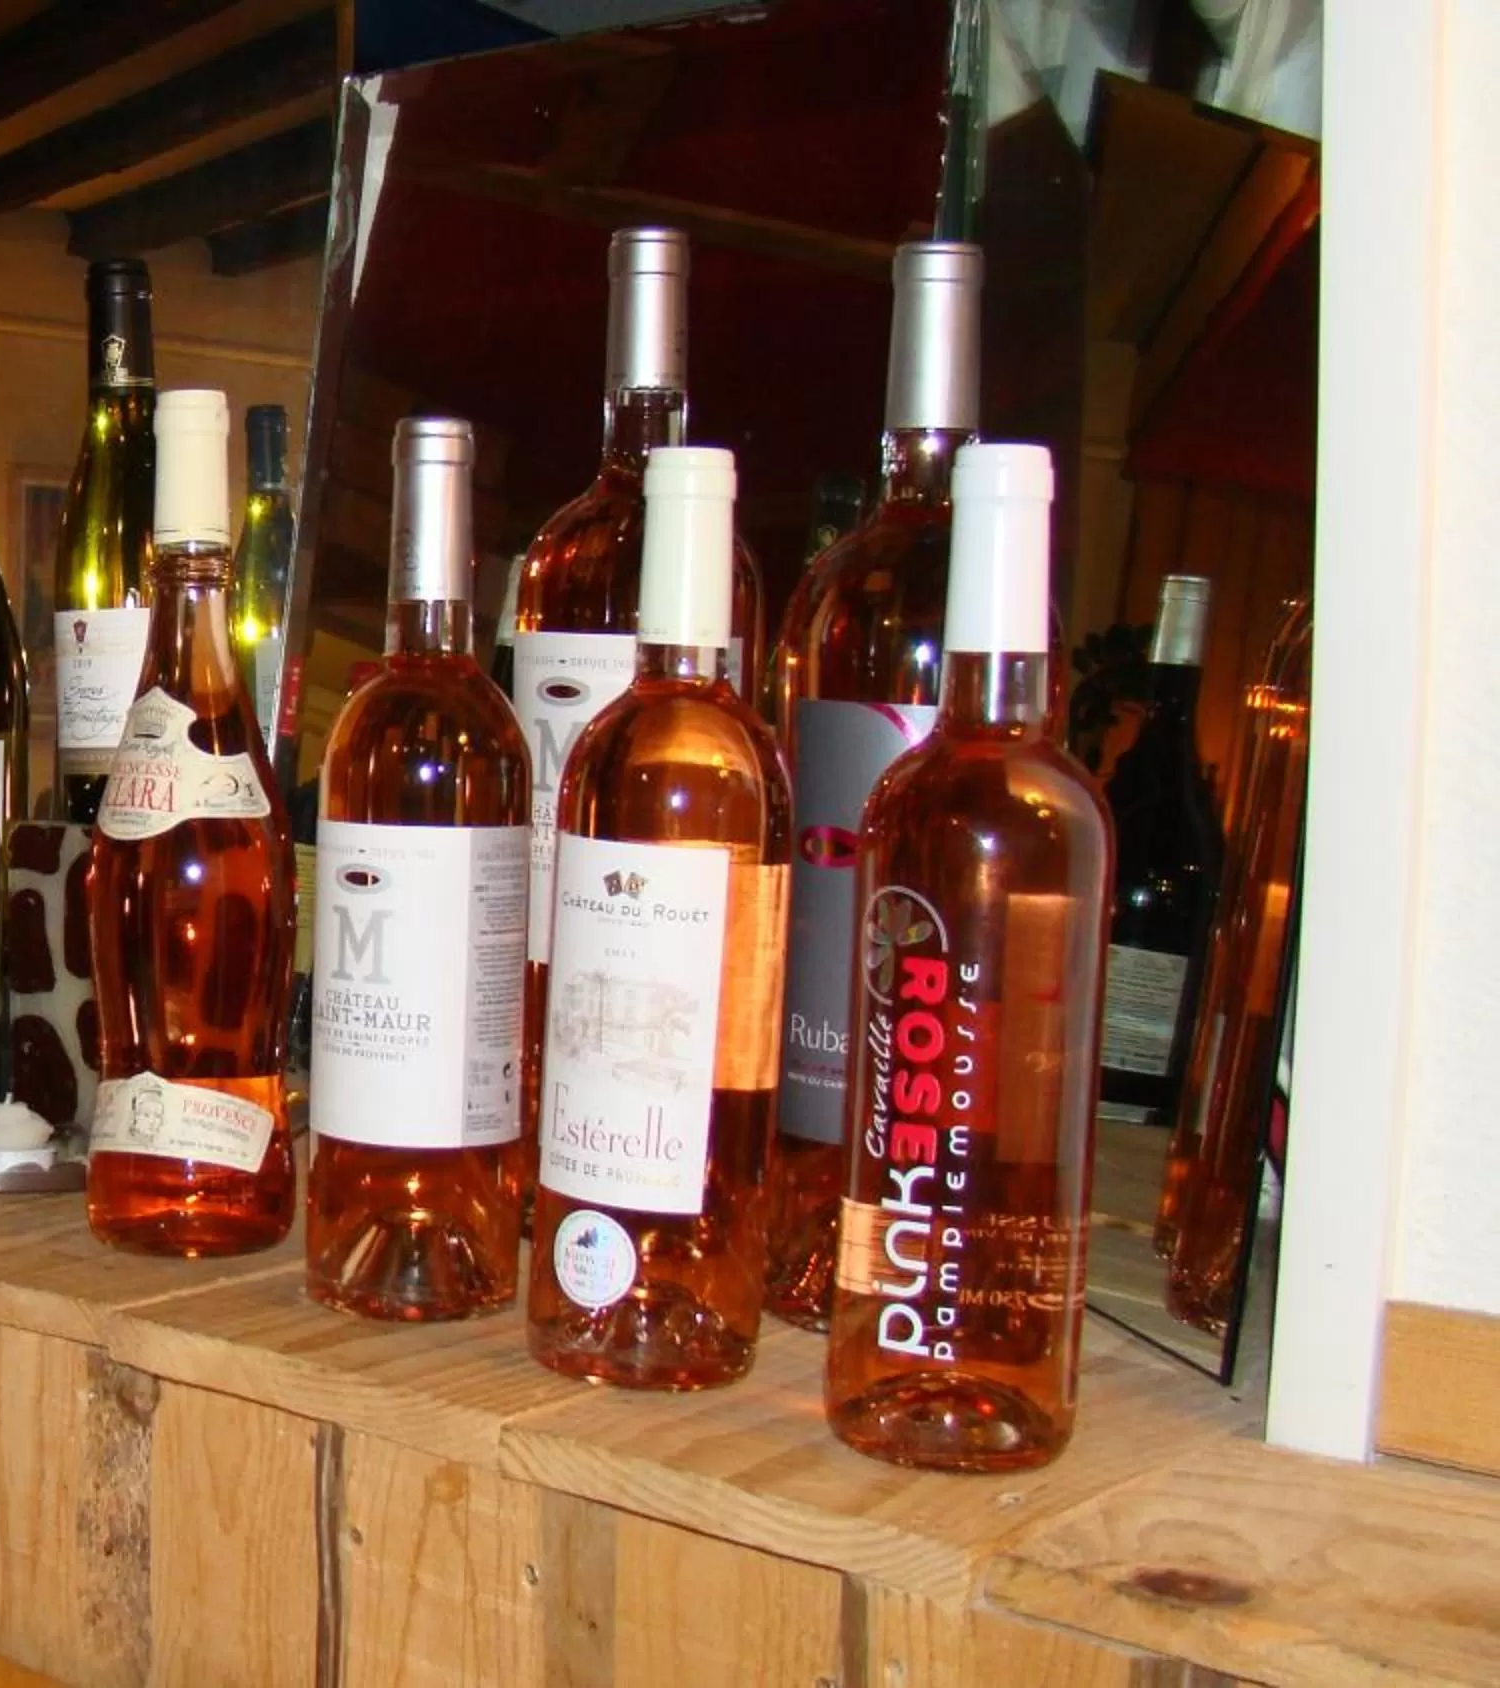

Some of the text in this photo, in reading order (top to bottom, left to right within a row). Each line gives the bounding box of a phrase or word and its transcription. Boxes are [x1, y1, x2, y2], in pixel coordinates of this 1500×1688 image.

[330, 903, 394, 986] M
[314, 1003, 432, 1033] AINT-MAUR
[888, 956, 948, 1166] ROSE
[551, 1081, 684, 1162] Estérelle
